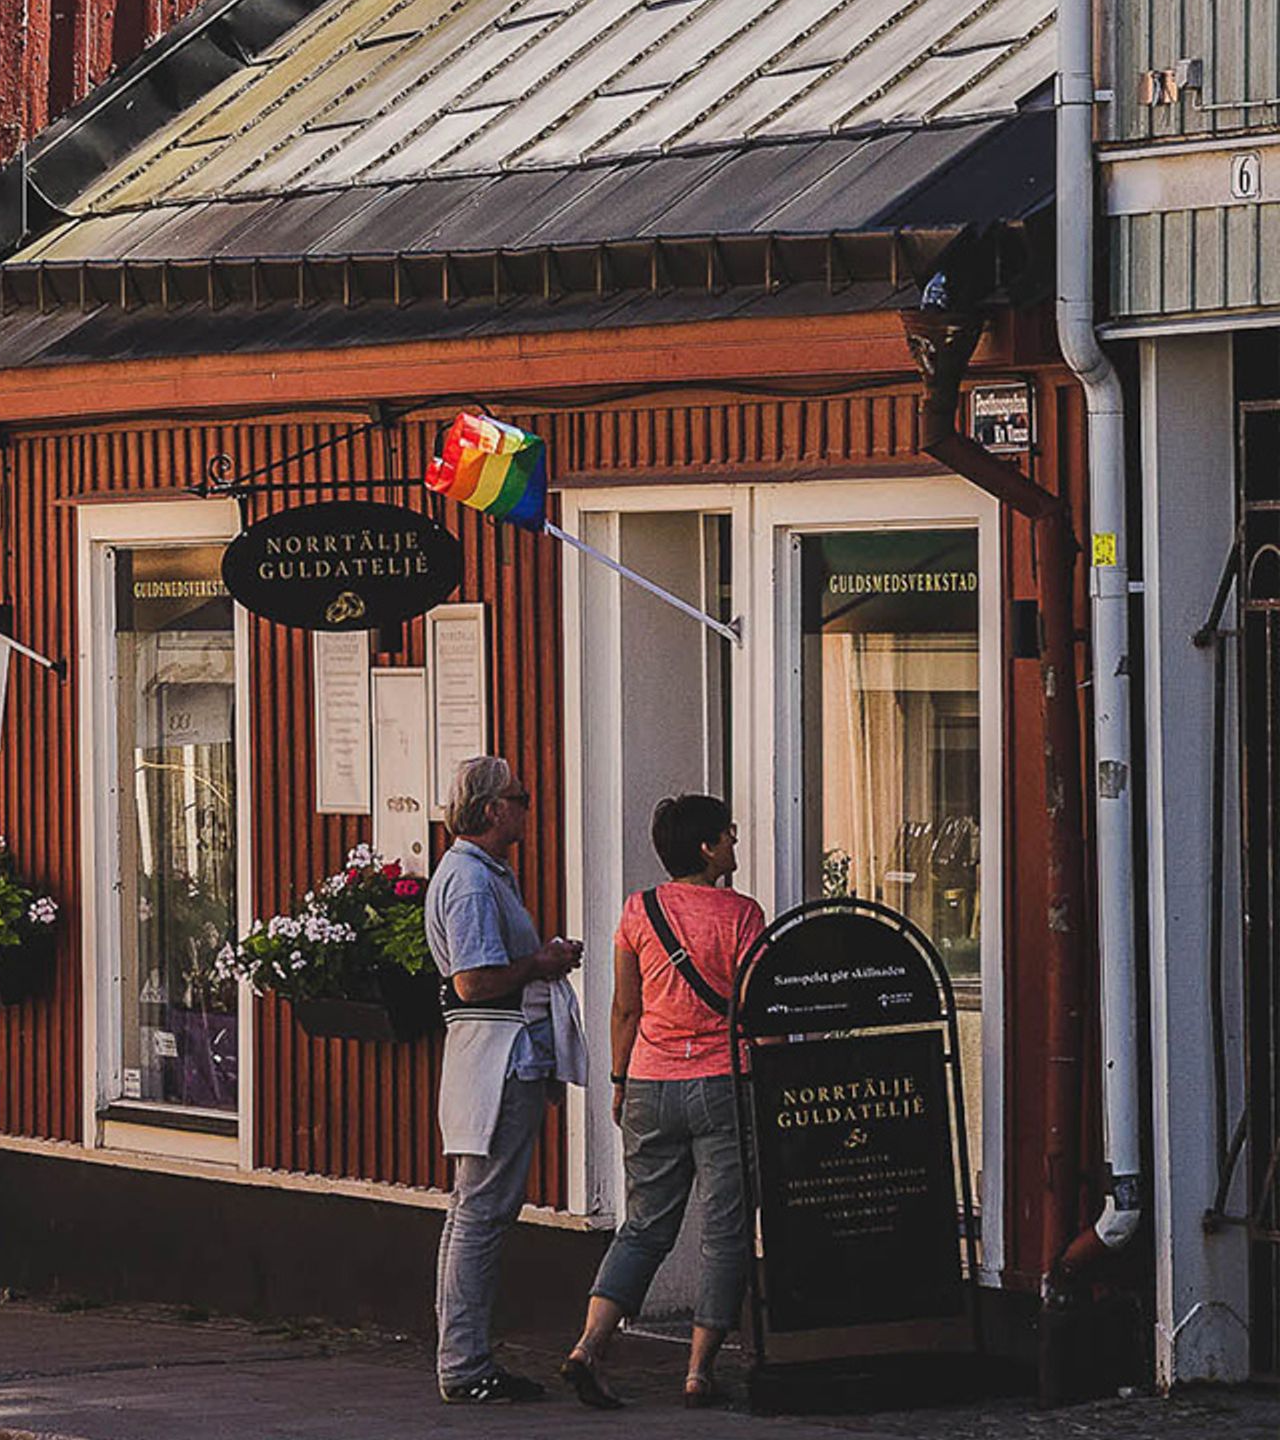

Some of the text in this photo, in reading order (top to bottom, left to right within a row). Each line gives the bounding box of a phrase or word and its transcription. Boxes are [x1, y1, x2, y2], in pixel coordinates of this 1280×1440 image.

[1239, 157, 1251, 194] 6
[266, 530, 418, 554] NORRTÄLJE
[259, 551, 429, 580] GULDATELJÉ
[829, 572, 978, 594] GULDSMEDSVERKSTAD
[783, 1077, 916, 1106] NORRTÄLJE
[777, 1094, 926, 1129] GULDATELJÉ
